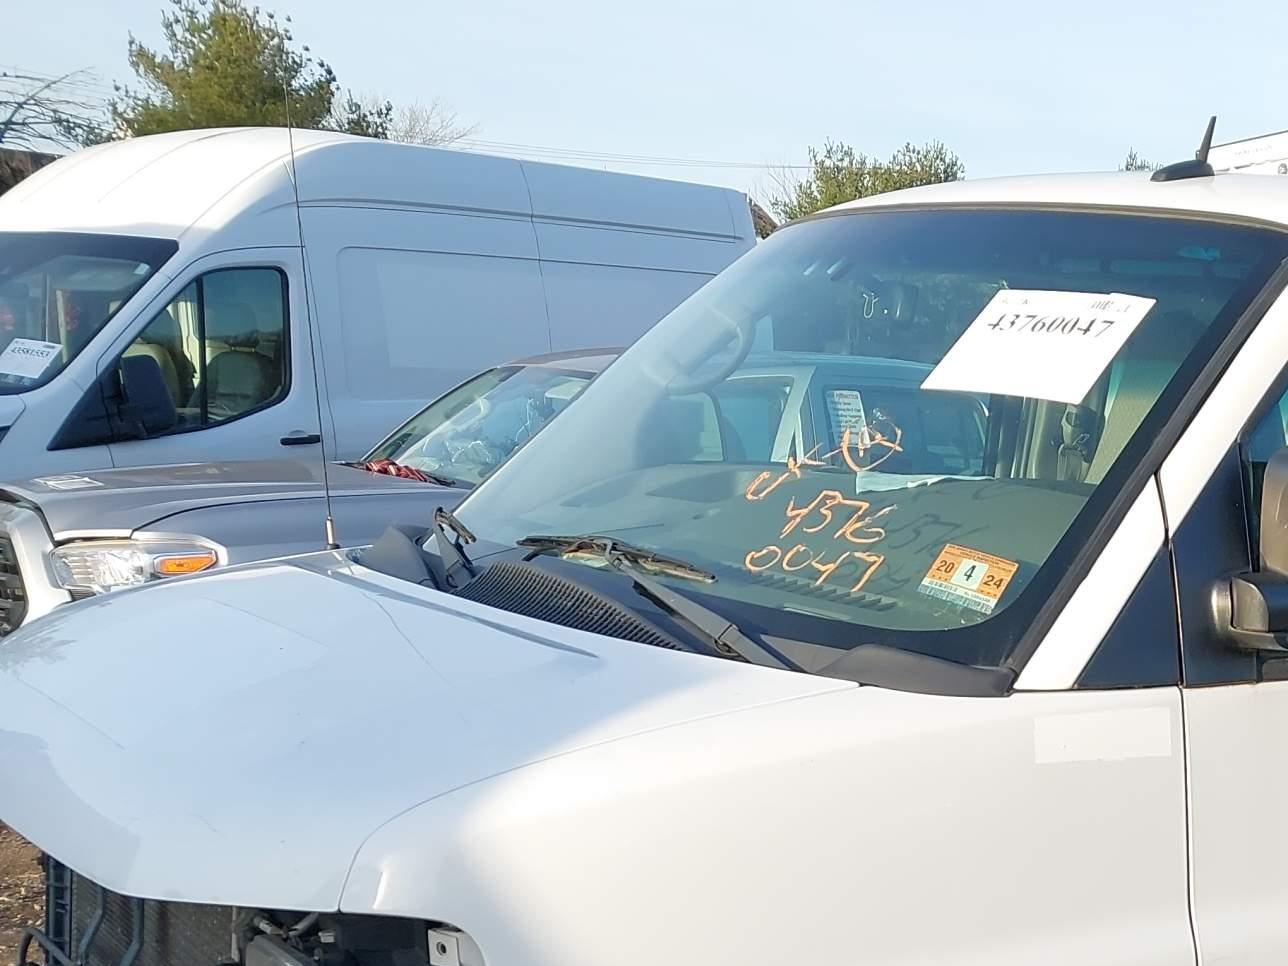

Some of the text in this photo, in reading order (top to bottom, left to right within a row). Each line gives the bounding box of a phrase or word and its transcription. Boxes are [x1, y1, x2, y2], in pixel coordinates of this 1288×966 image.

[987, 312, 1116, 338] 43760047
[936, 559, 955, 574] 20
[963, 564, 977, 582] 4
[983, 574, 1004, 590] 24
